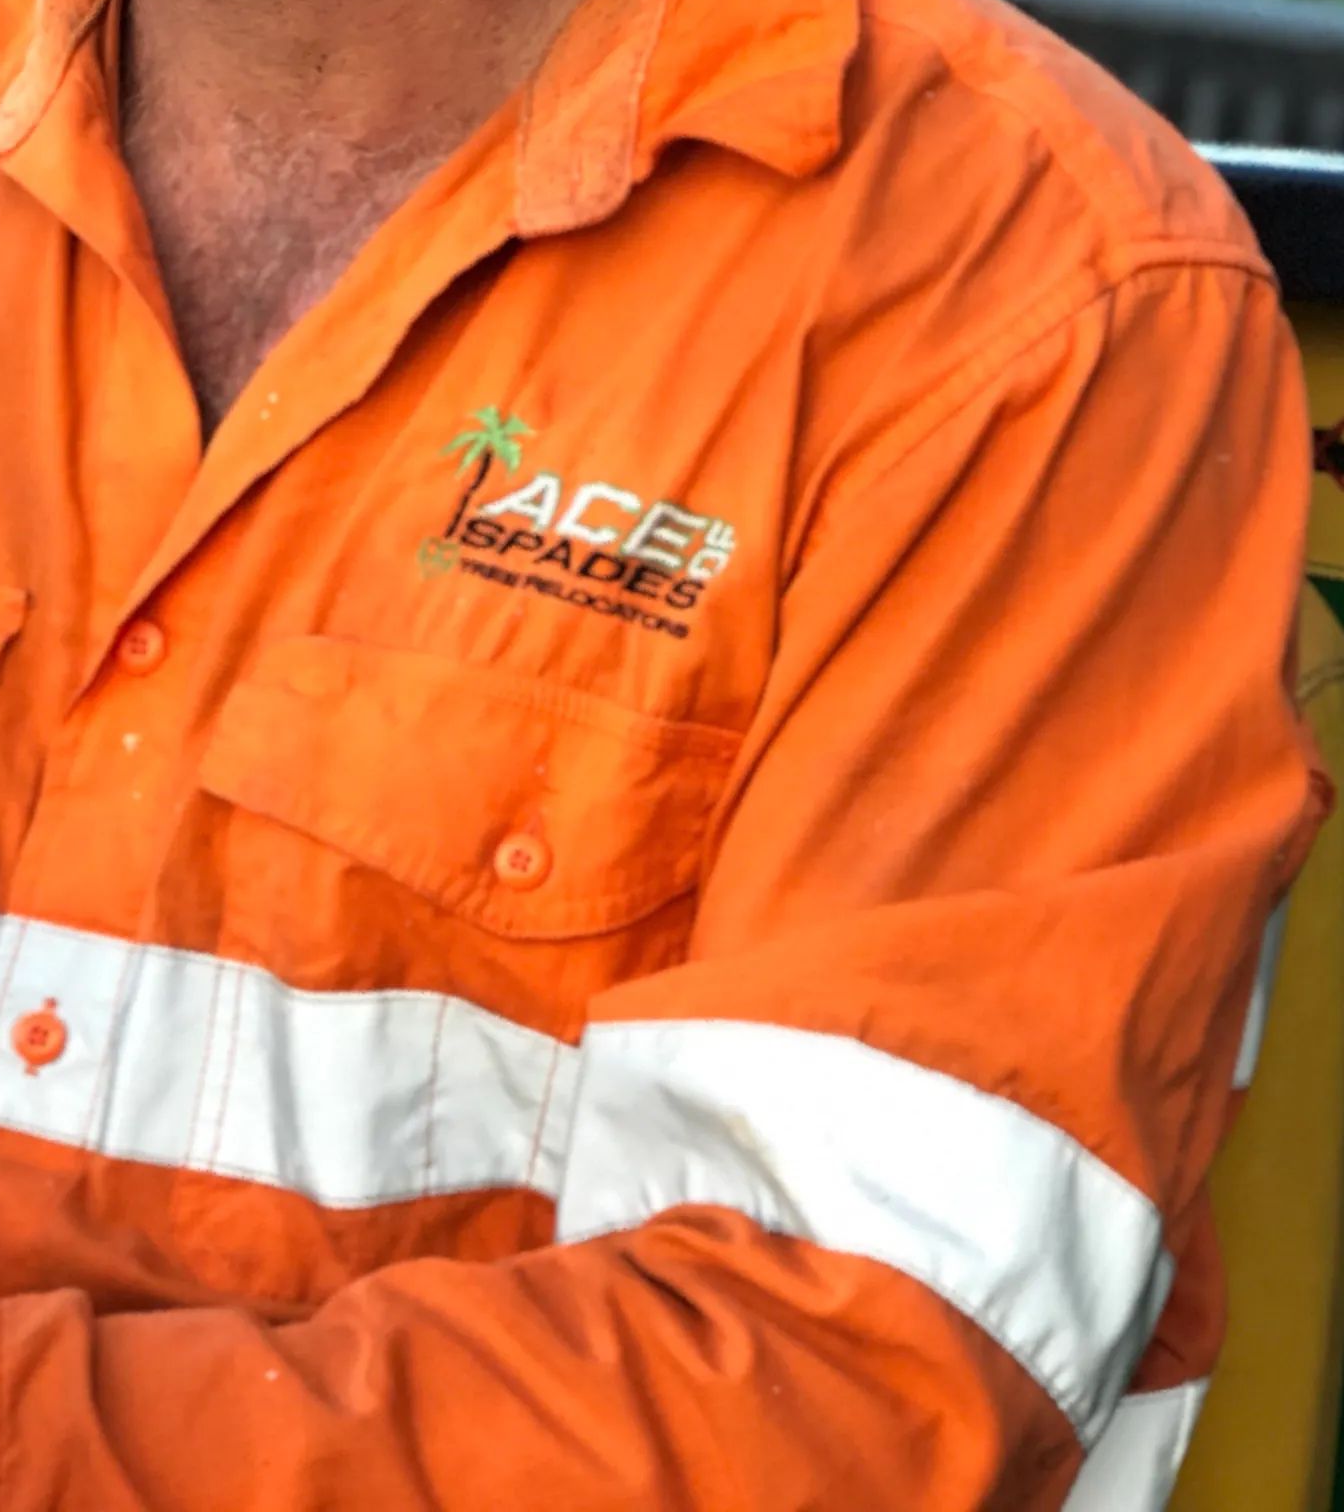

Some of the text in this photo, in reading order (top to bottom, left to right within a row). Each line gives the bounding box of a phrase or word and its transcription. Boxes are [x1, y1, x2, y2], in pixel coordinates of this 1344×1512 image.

[459, 517, 704, 609] SPADES
[476, 471, 736, 579] ACE OF
[460, 557, 689, 639] TREE RELOCATORS
